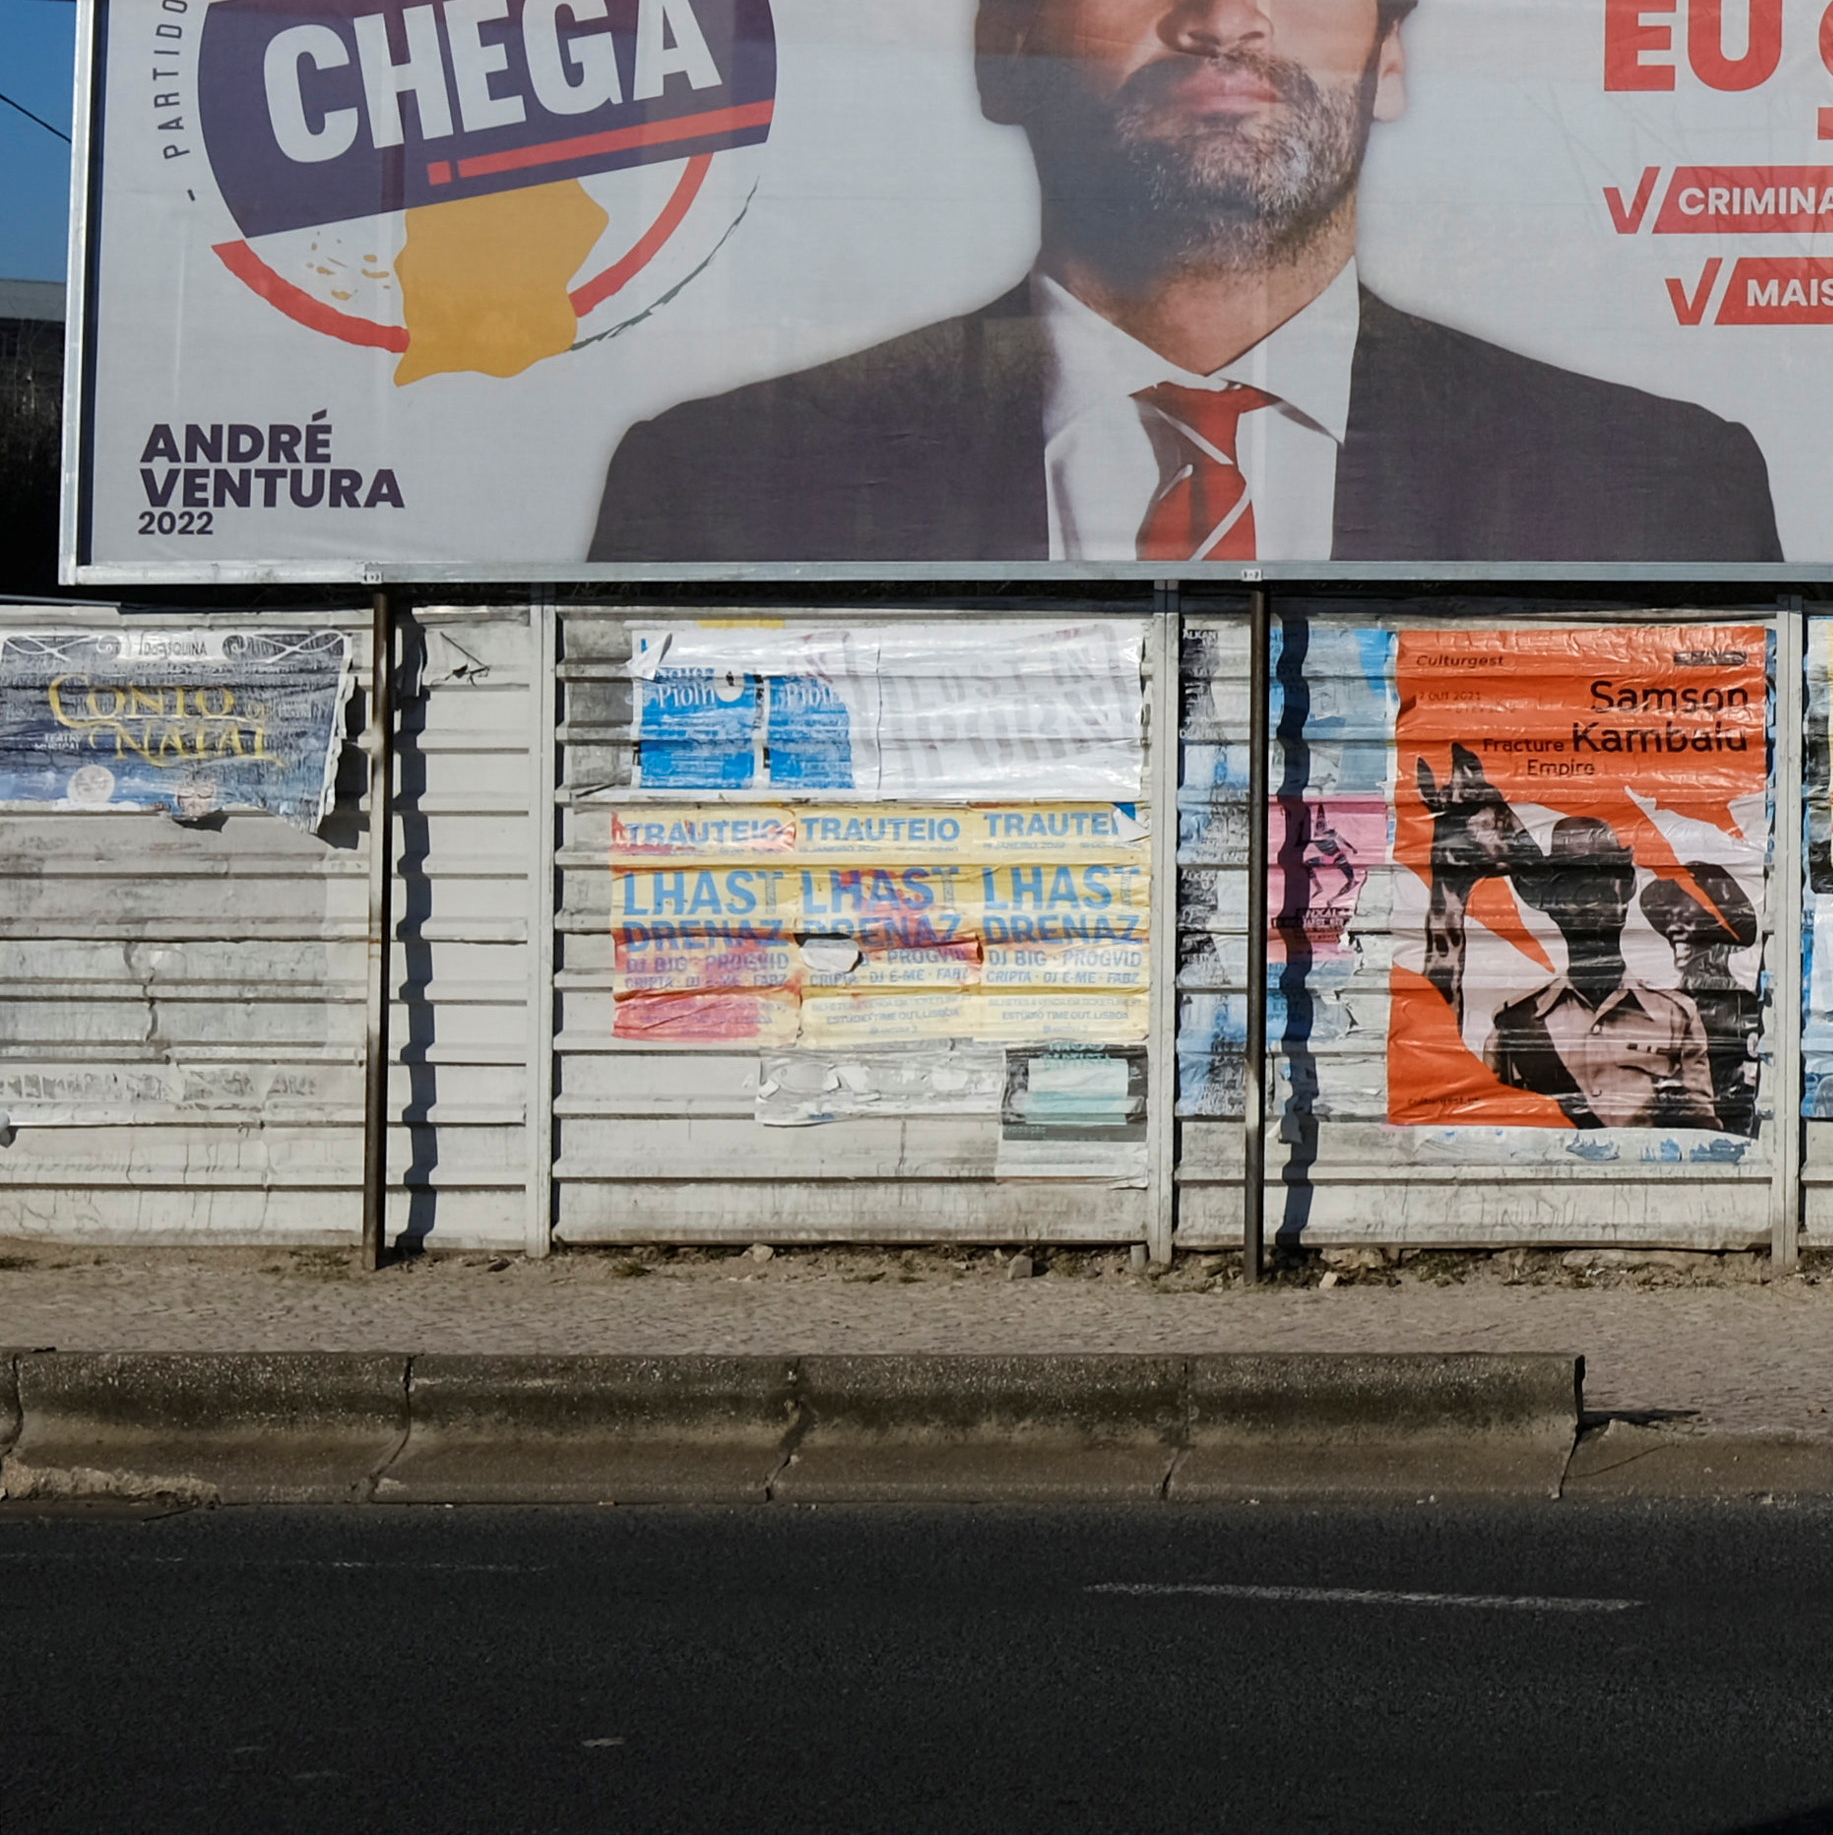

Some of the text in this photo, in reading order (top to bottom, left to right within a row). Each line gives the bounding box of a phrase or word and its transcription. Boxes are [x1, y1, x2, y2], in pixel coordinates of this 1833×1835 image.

[140, 410, 332, 464] ANDRÉ
[140, 469, 405, 508] VENTURA
[137, 512, 213, 536] 2022
[1417, 655, 1504, 667] Culturgest
[1590, 681, 1747, 713] Samson
[1483, 739, 1564, 752] Fracture
[1573, 720, 1747, 753] Kambalu
[1528, 760, 1594, 776] Empire
[801, 818, 960, 841] TRAUTEIO
[623, 870, 783, 916] LHAST
[802, 867, 959, 913] LHAST
[982, 866, 1140, 910] LHAST
[623, 920, 788, 951] DRENAZ
[982, 914, 1143, 944] DRENAZ
[989, 950, 1142, 966] DJ BIG PROGVID
